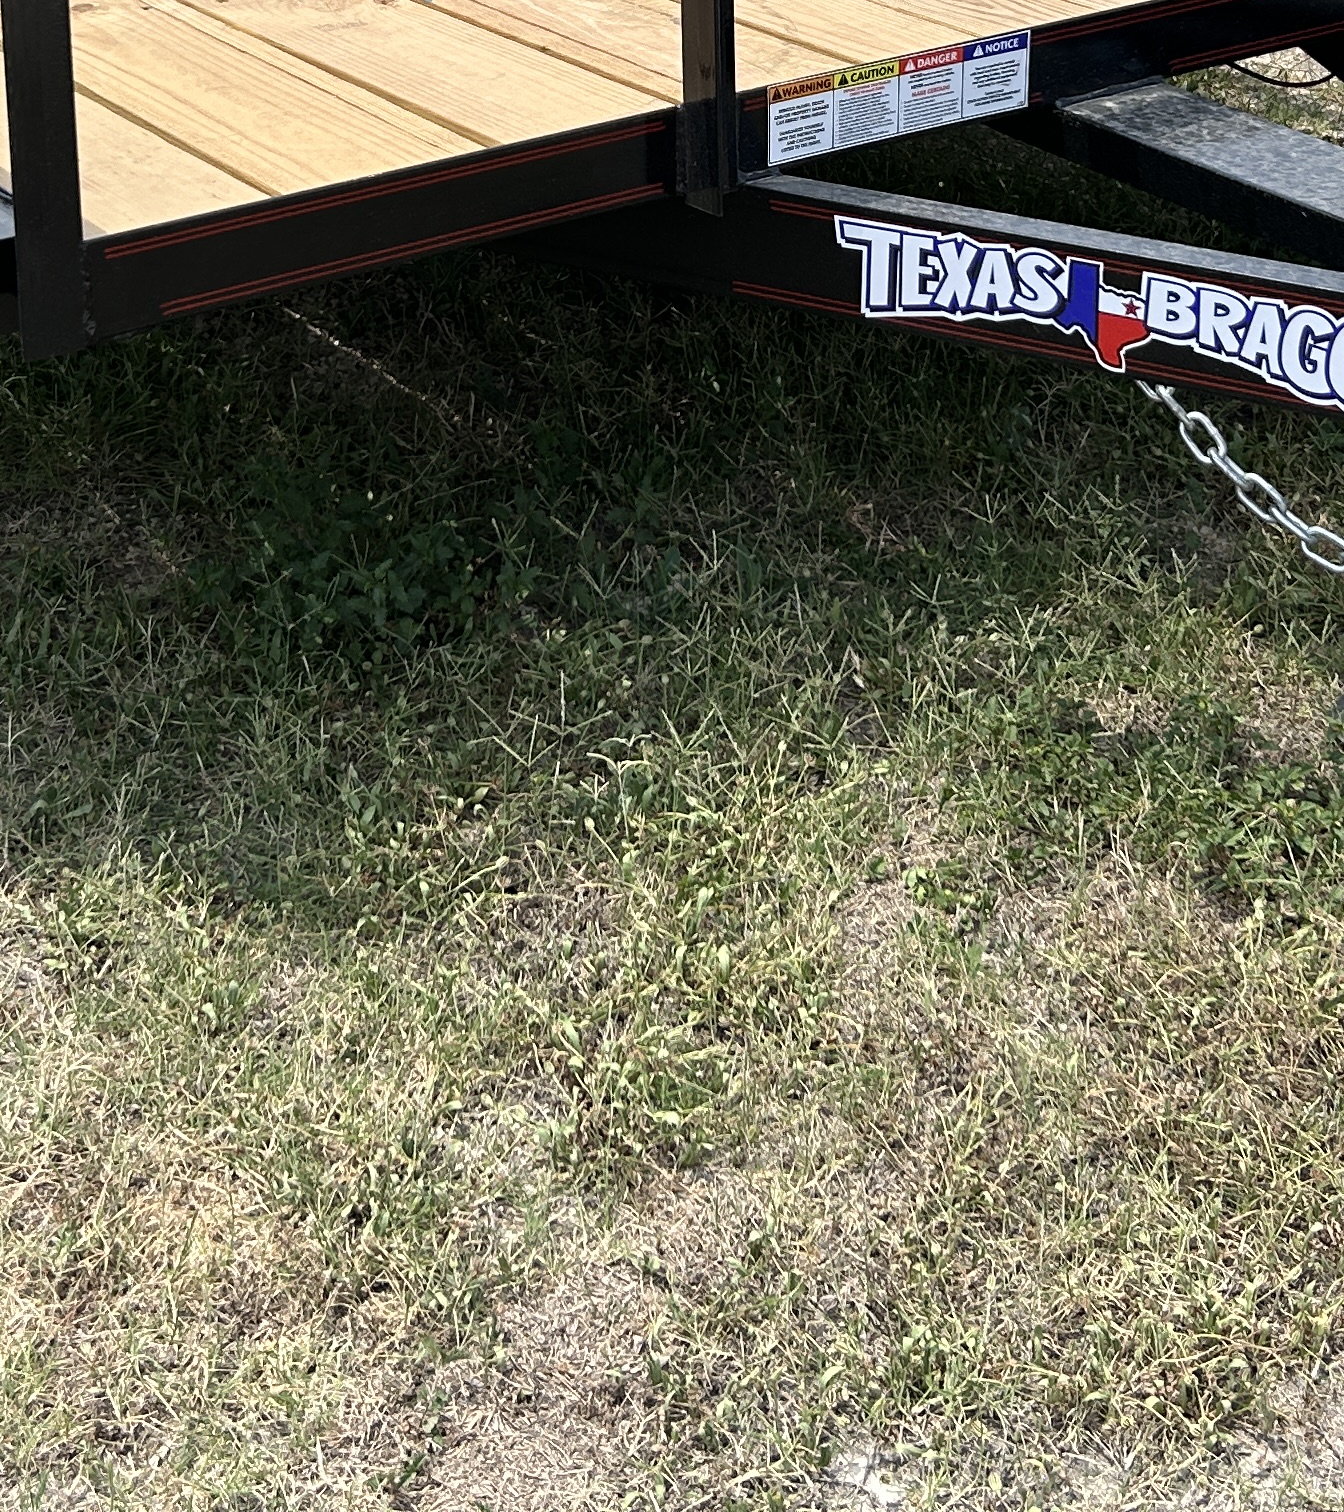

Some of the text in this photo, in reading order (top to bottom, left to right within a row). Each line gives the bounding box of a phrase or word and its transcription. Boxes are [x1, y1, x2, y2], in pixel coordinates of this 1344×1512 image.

[985, 38, 1019, 54] NOTICE
[917, 52, 958, 68] DANGER
[850, 64, 895, 84] CAUTION
[781, 78, 832, 98] WARNING
[836, 217, 1064, 318] TEXAS
